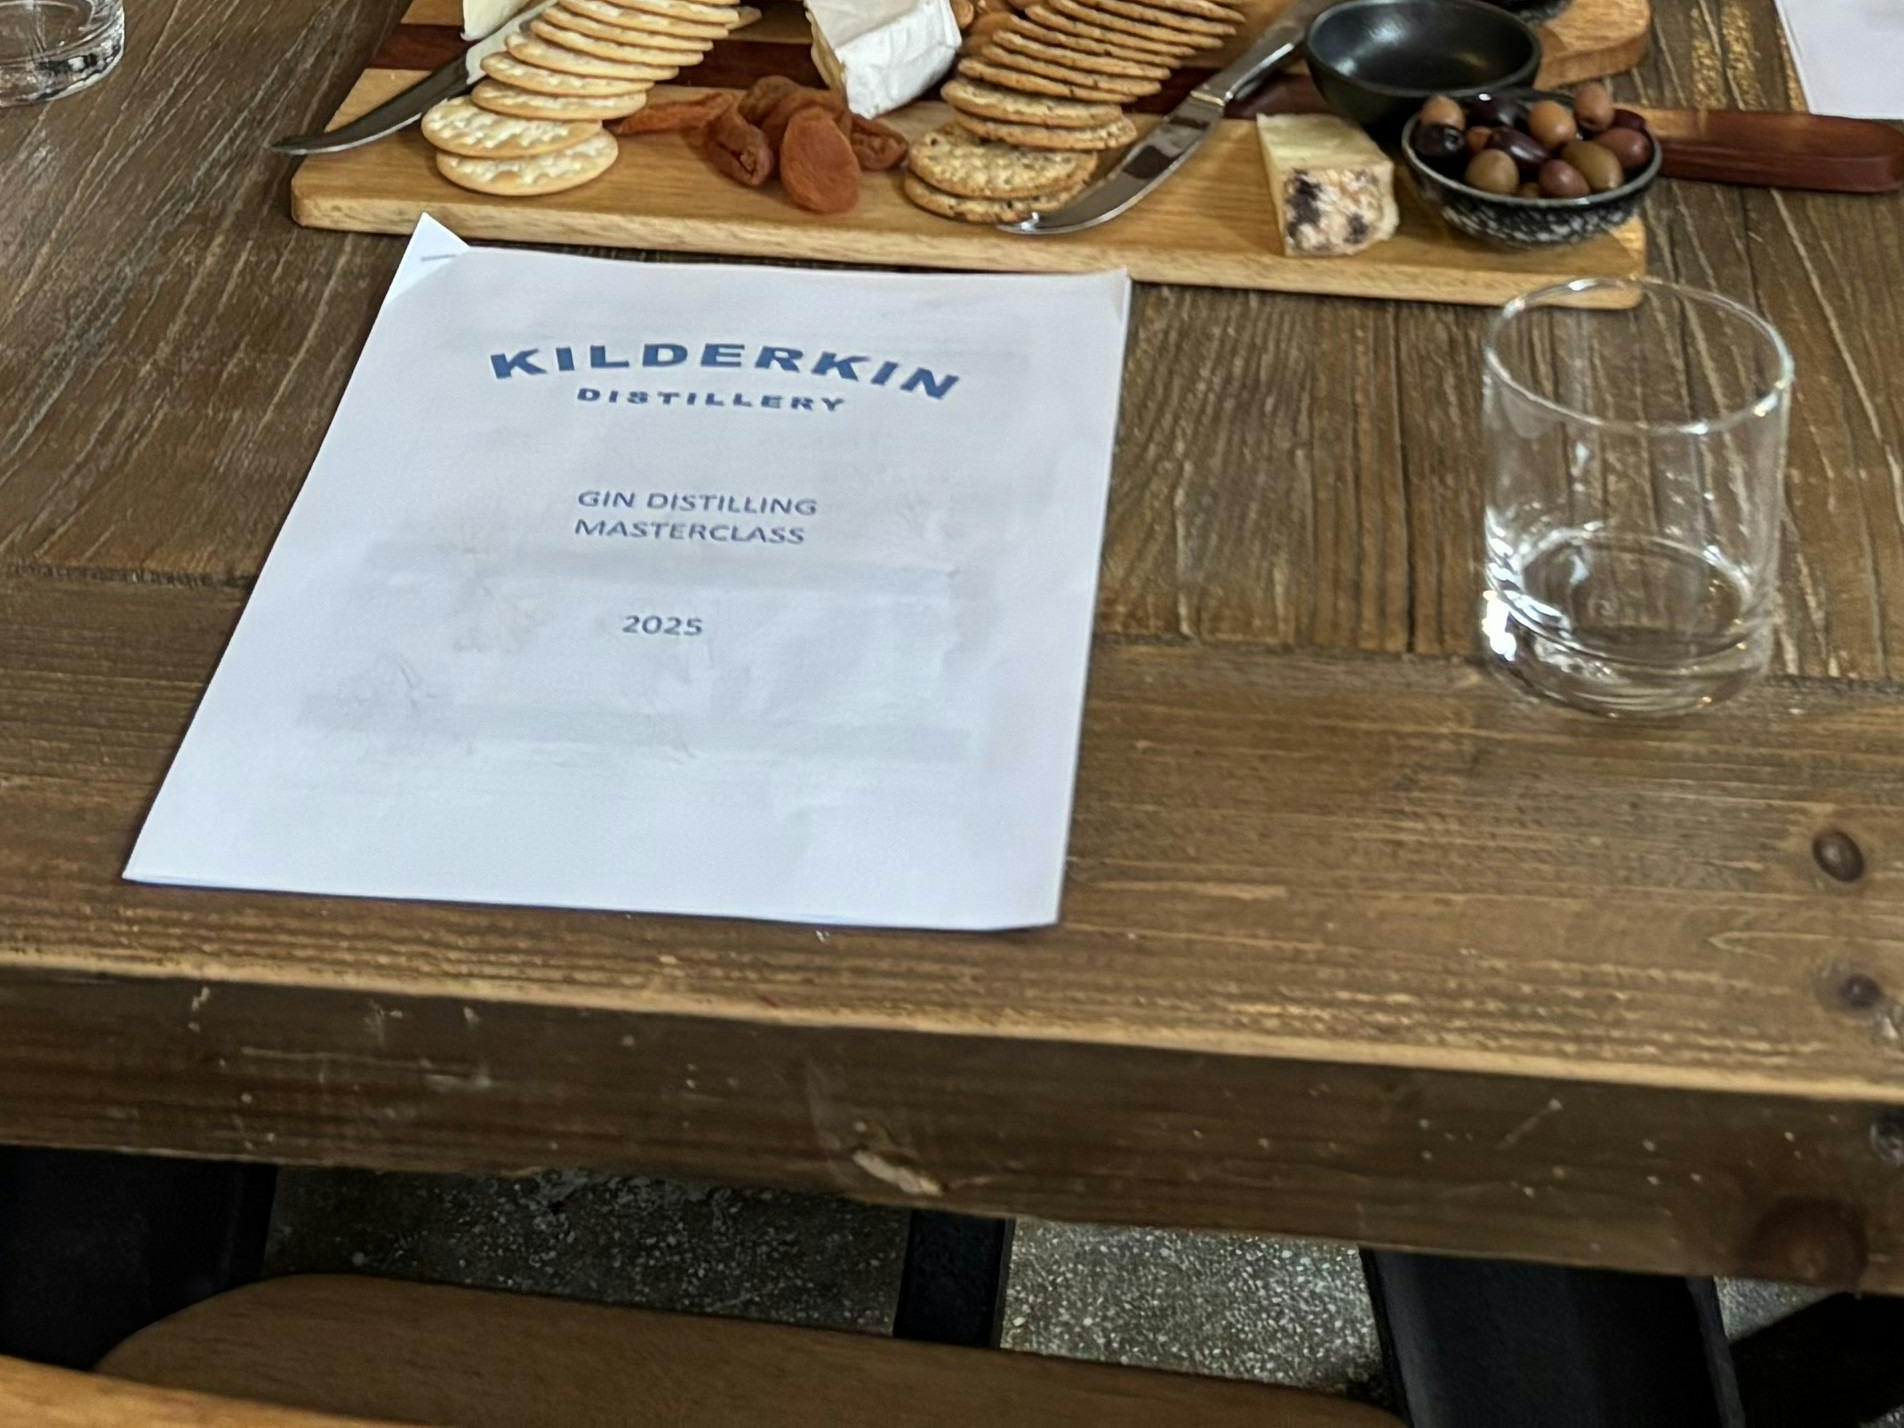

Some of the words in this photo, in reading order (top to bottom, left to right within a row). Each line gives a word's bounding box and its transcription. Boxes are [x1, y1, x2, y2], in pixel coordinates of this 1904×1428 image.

[488, 342, 961, 403] KILDERKIN
[575, 387, 847, 415] DISTILLERY
[576, 490, 636, 511] GIN
[645, 492, 819, 518] DISTILLING
[573, 517, 807, 546] MASTERCLASS
[621, 612, 704, 638] 2025
